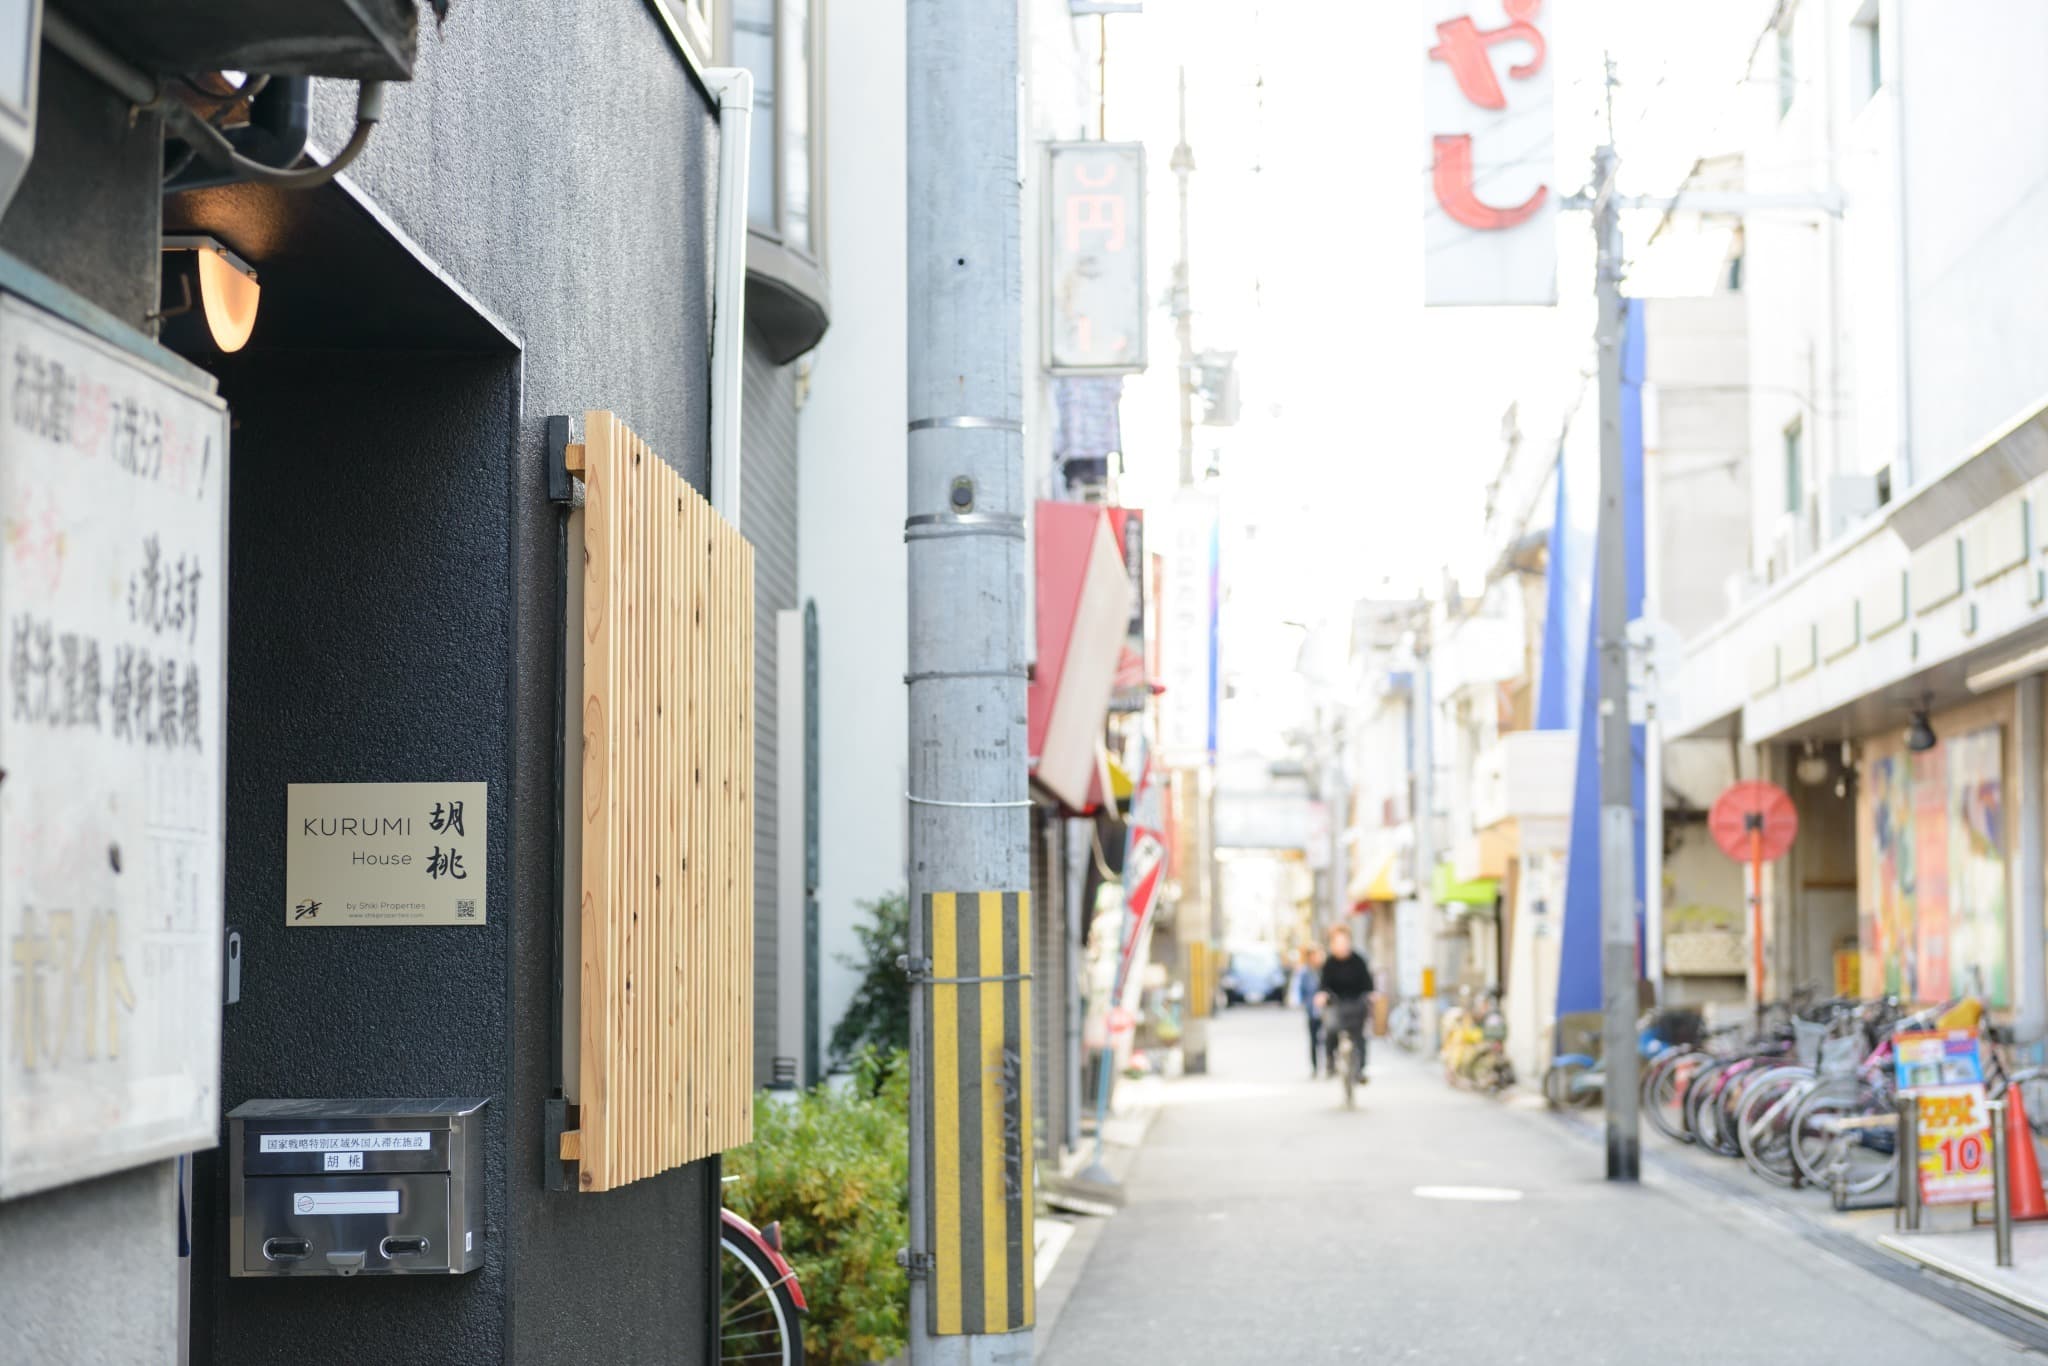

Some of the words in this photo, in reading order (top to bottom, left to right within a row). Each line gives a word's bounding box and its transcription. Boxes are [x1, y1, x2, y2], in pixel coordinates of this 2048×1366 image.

[304, 818, 411, 836] KURUMI
[426, 801, 467, 880] 胡桃
[352, 851, 412, 866] House
[346, 902, 357, 910] by
[380, 902, 426, 911] Properties
[1939, 1136, 1983, 1173] 10
